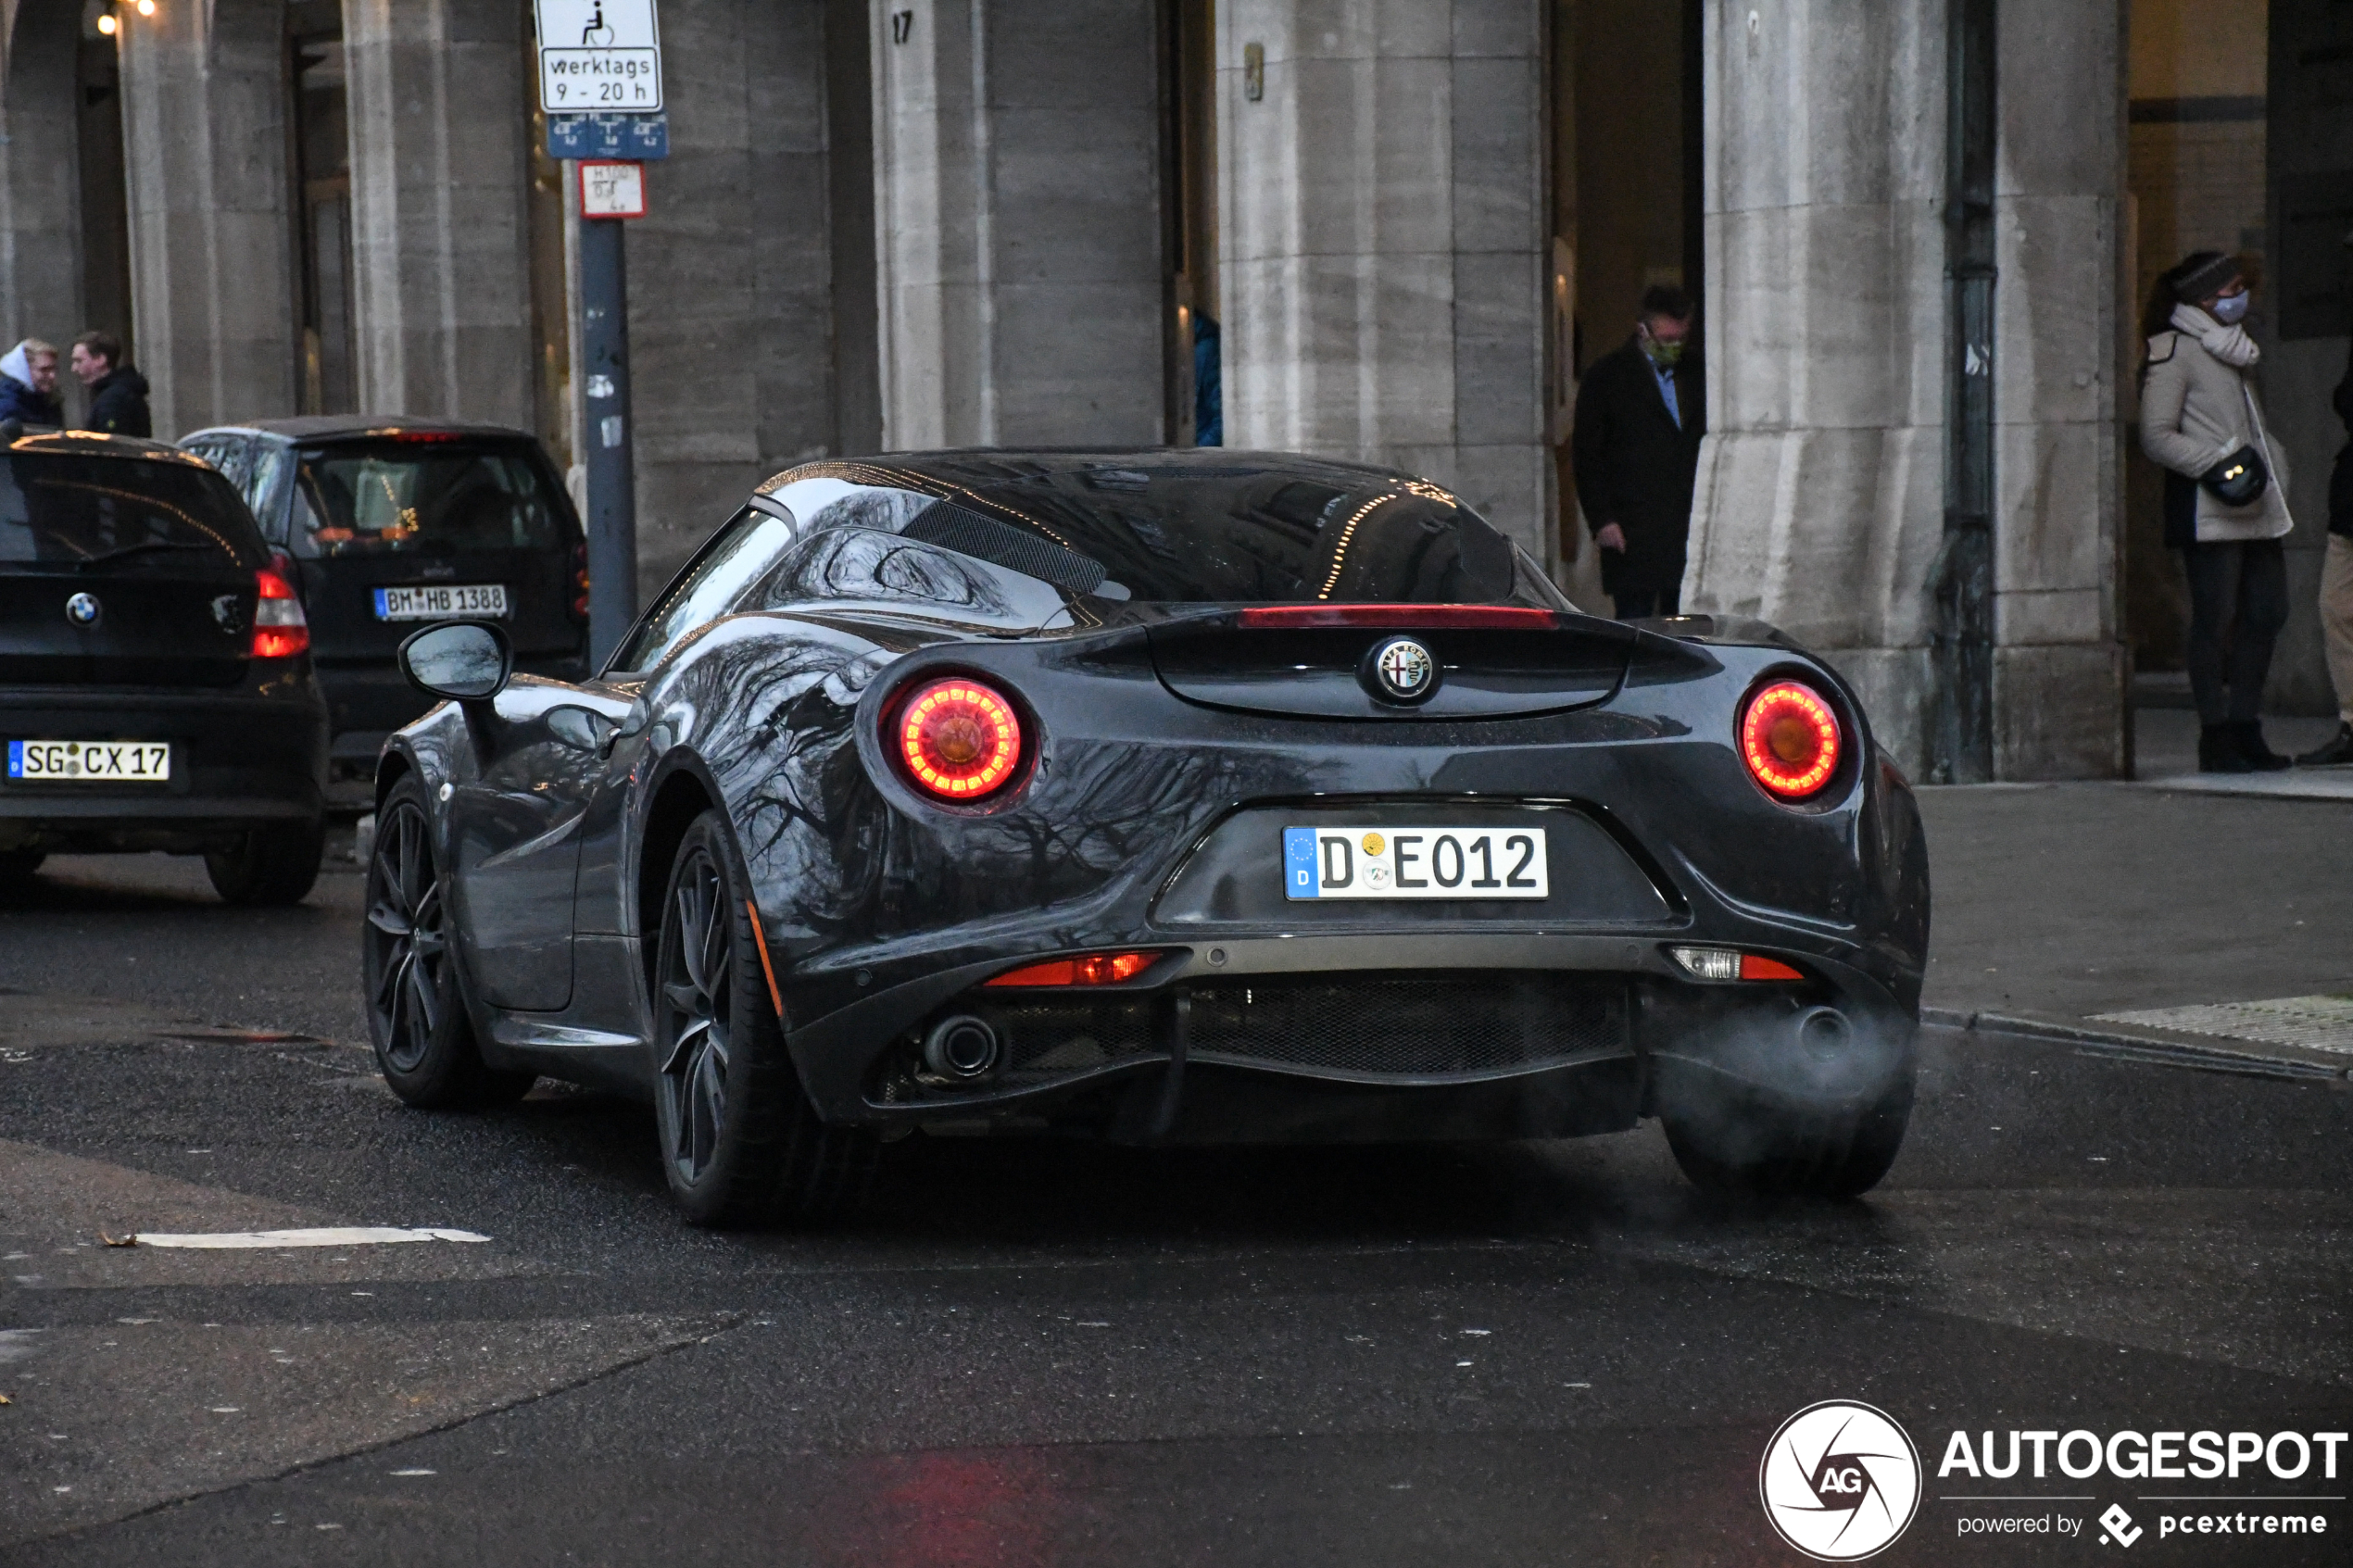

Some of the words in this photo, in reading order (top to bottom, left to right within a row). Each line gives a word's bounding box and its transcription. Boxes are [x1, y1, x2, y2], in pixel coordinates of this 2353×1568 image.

[893, 9, 913, 44] 17
[550, 56, 650, 79] werktags
[557, 82, 567, 101] 9
[599, 82, 623, 101] 20
[635, 82, 647, 100] h
[387, 590, 413, 612] BM
[426, 589, 452, 611] HB
[456, 587, 503, 610] 1388
[26, 746, 64, 773] SG
[85, 746, 123, 774] CX
[132, 747, 166, 775] 17
[1319, 836, 1354, 888] D
[1297, 870, 1310, 886] D
